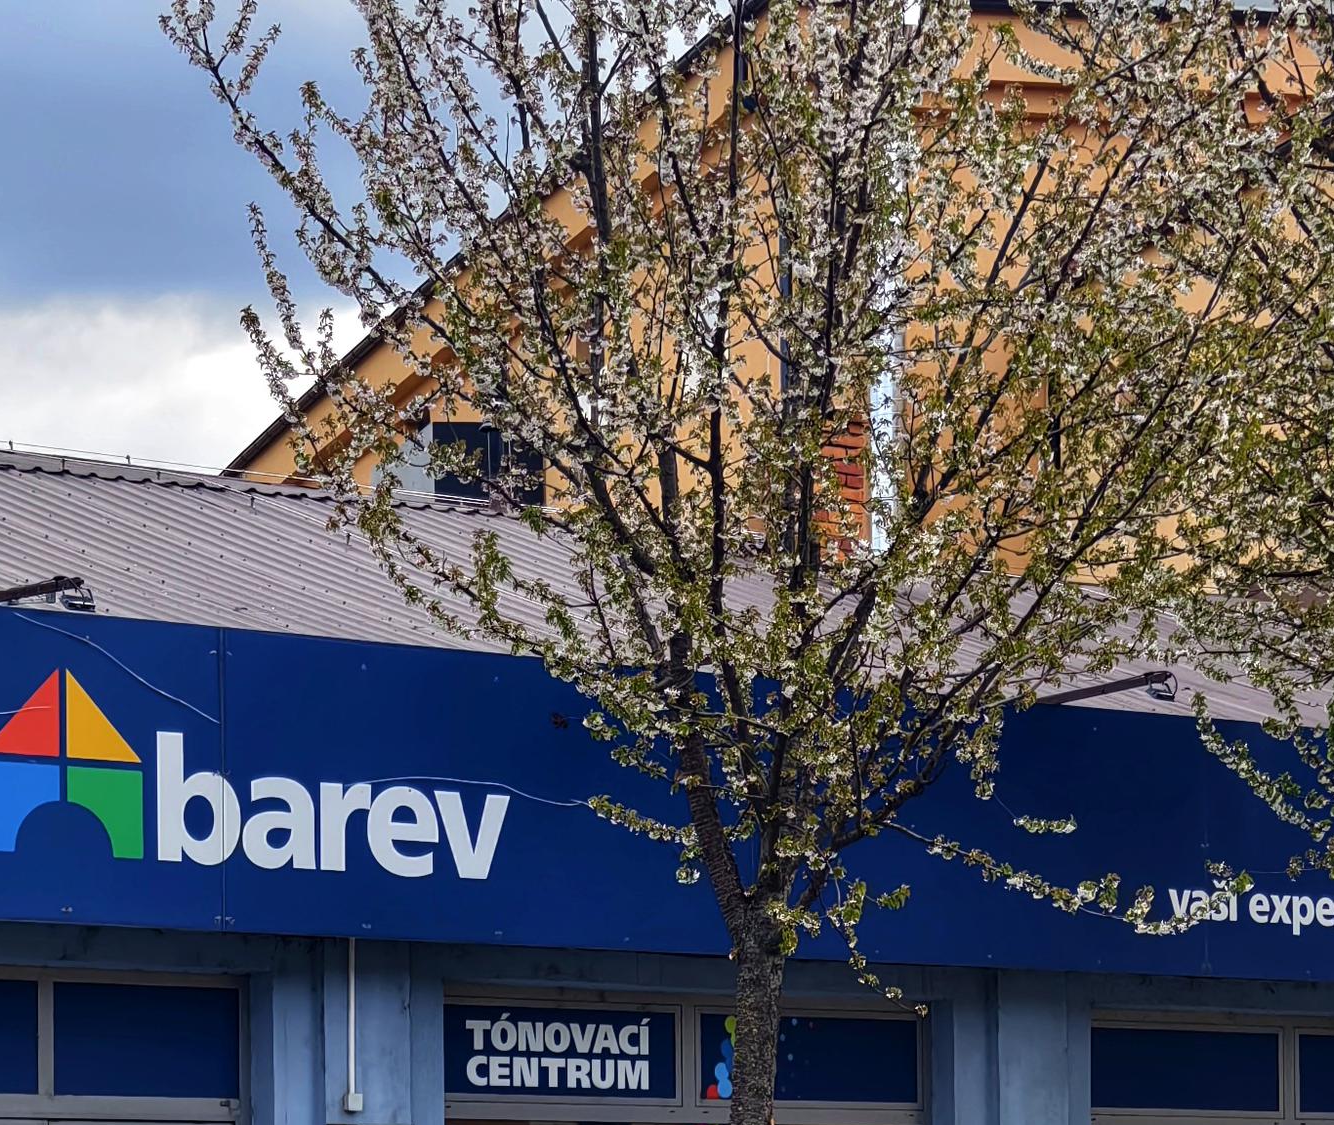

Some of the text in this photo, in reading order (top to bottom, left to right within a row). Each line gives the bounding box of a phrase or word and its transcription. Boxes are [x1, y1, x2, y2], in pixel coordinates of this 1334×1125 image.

[157, 731, 509, 880] barev
[1168, 879, 1237, 922] vaši
[466, 1013, 649, 1056] TÓNOVACÍ
[466, 1056, 649, 1091] CENTRUM
